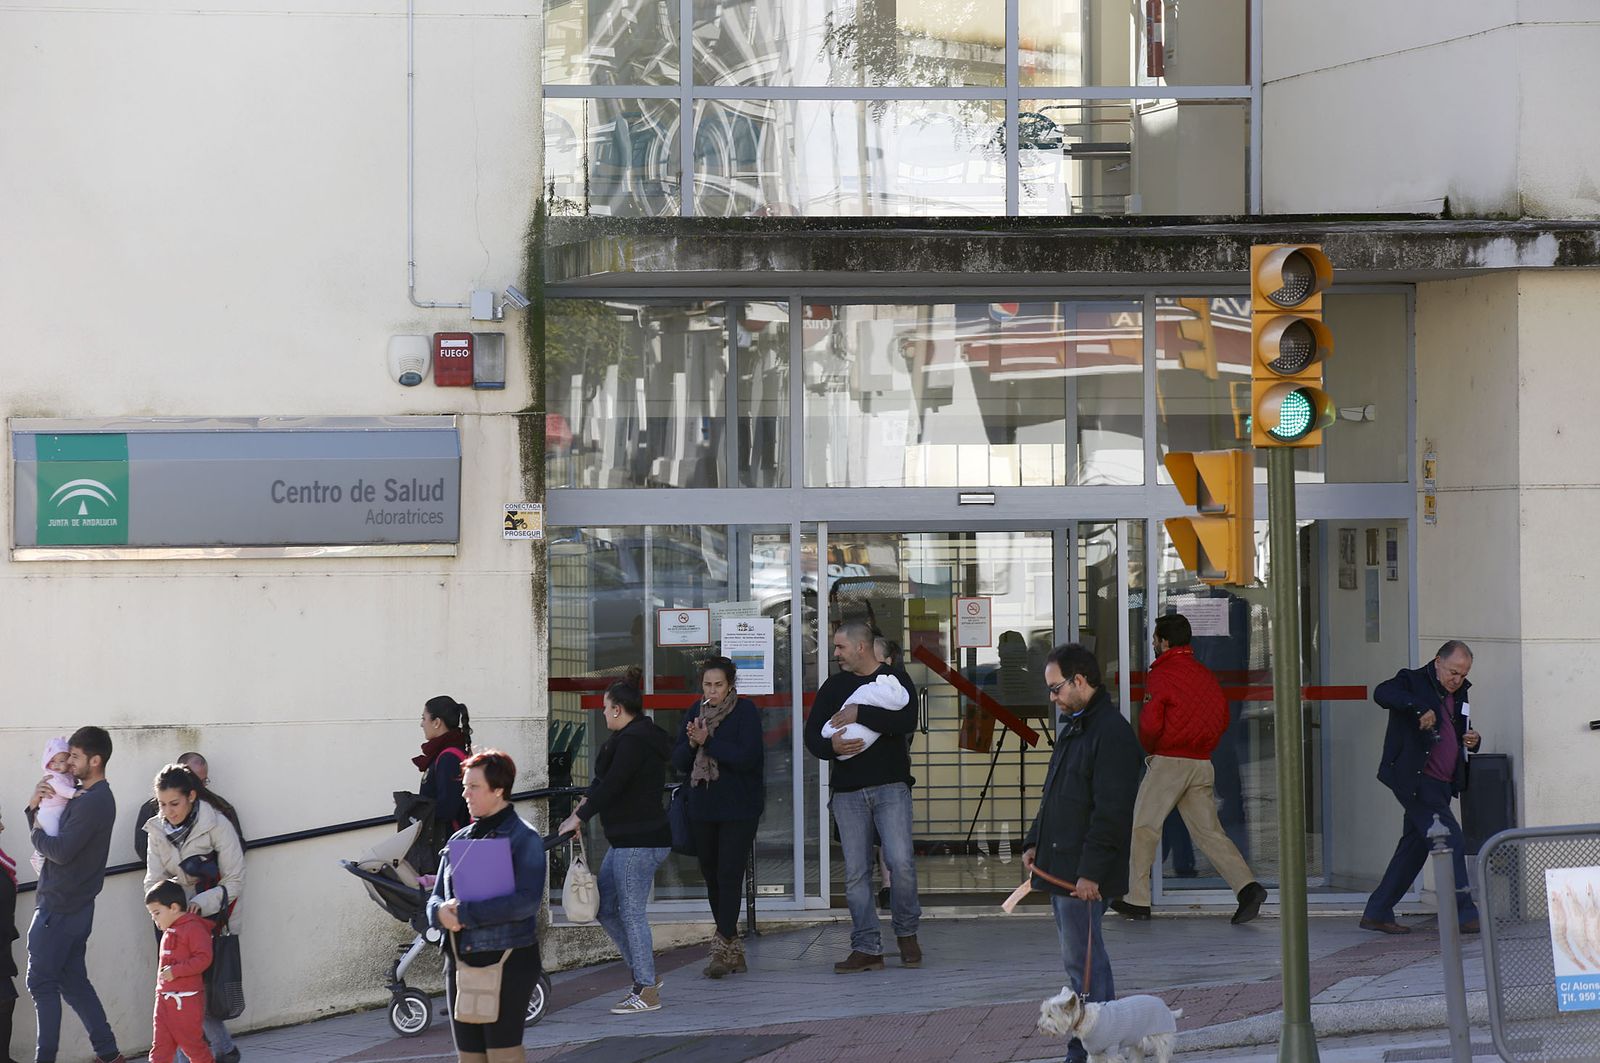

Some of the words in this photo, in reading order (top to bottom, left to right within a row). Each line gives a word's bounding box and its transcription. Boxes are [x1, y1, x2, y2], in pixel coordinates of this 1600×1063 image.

[440, 349, 469, 358] FUEGO
[271, 479, 342, 504] Centro
[350, 478, 376, 503] de
[384, 477, 444, 502] Salud
[365, 508, 444, 525] Adoratrices
[48, 518, 69, 527] JUNTA
[71, 518, 80, 526] DE
[1560, 982, 1571, 991] C/
[1579, 992, 1596, 1002] 959
